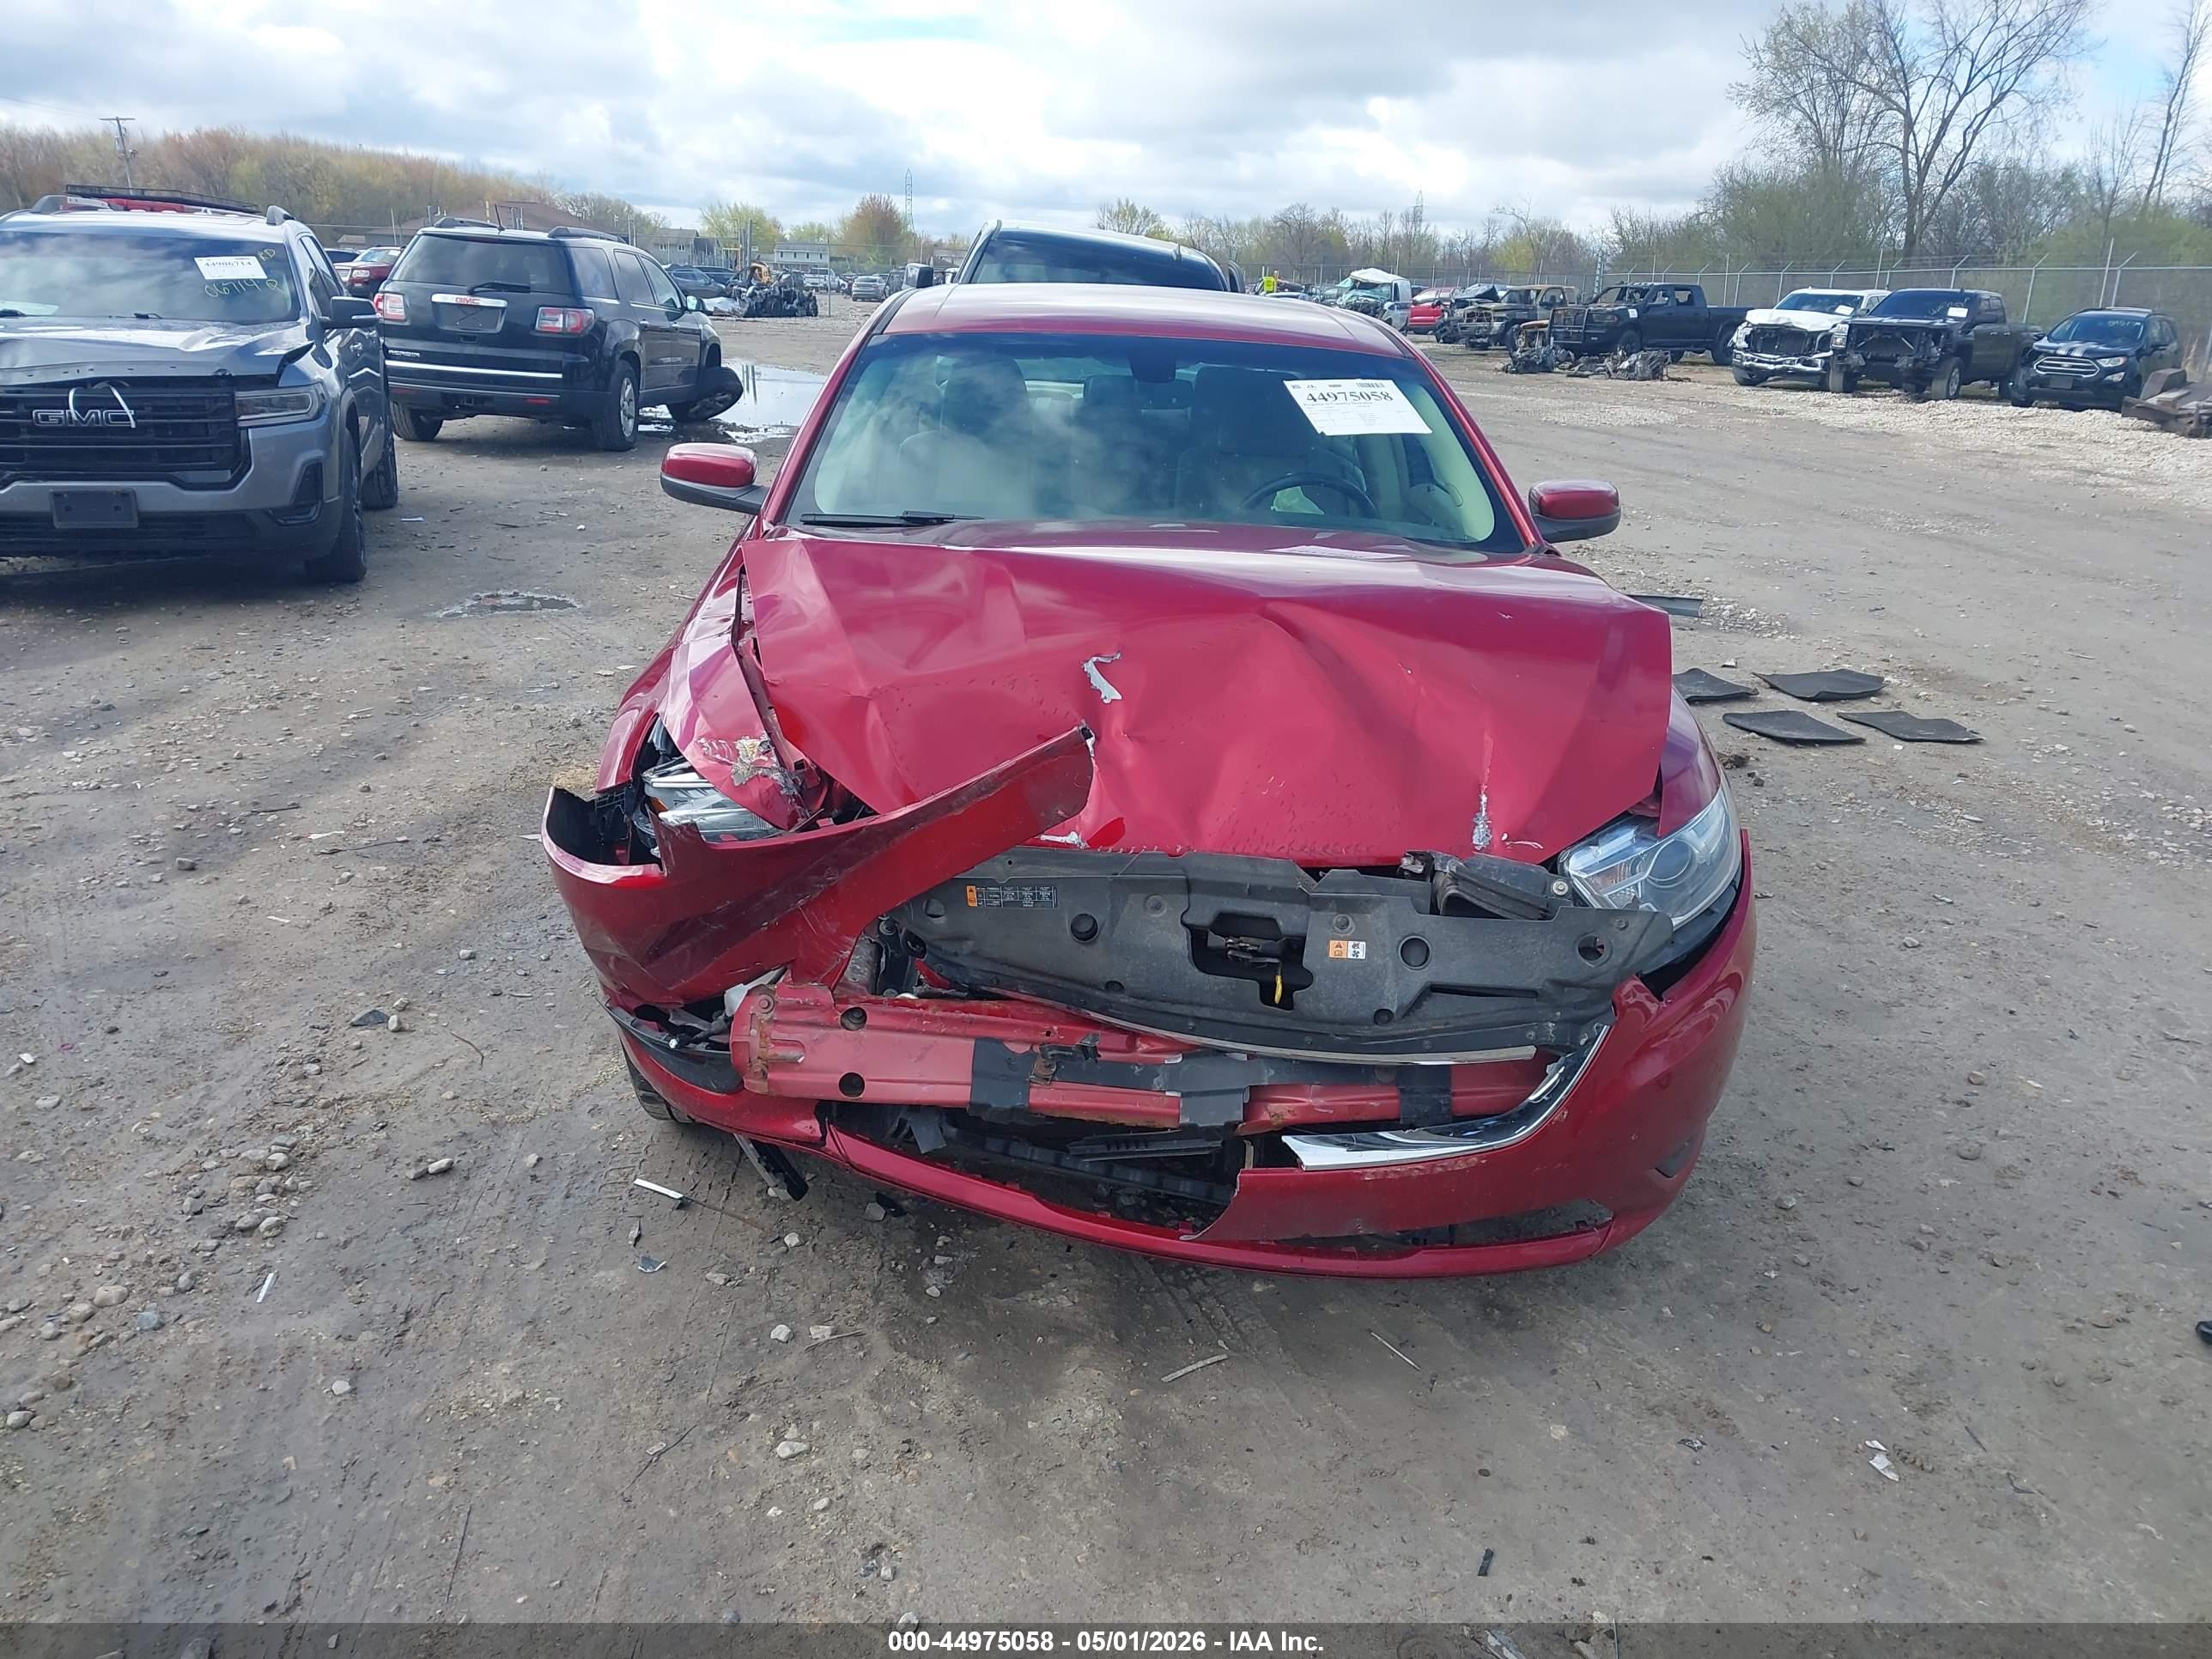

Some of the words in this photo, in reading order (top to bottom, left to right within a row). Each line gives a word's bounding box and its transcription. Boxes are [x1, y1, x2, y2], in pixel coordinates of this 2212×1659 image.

[454, 296, 480, 305] GMC
[1306, 391, 1394, 403] 44975058
[32, 409, 135, 427] GMC
